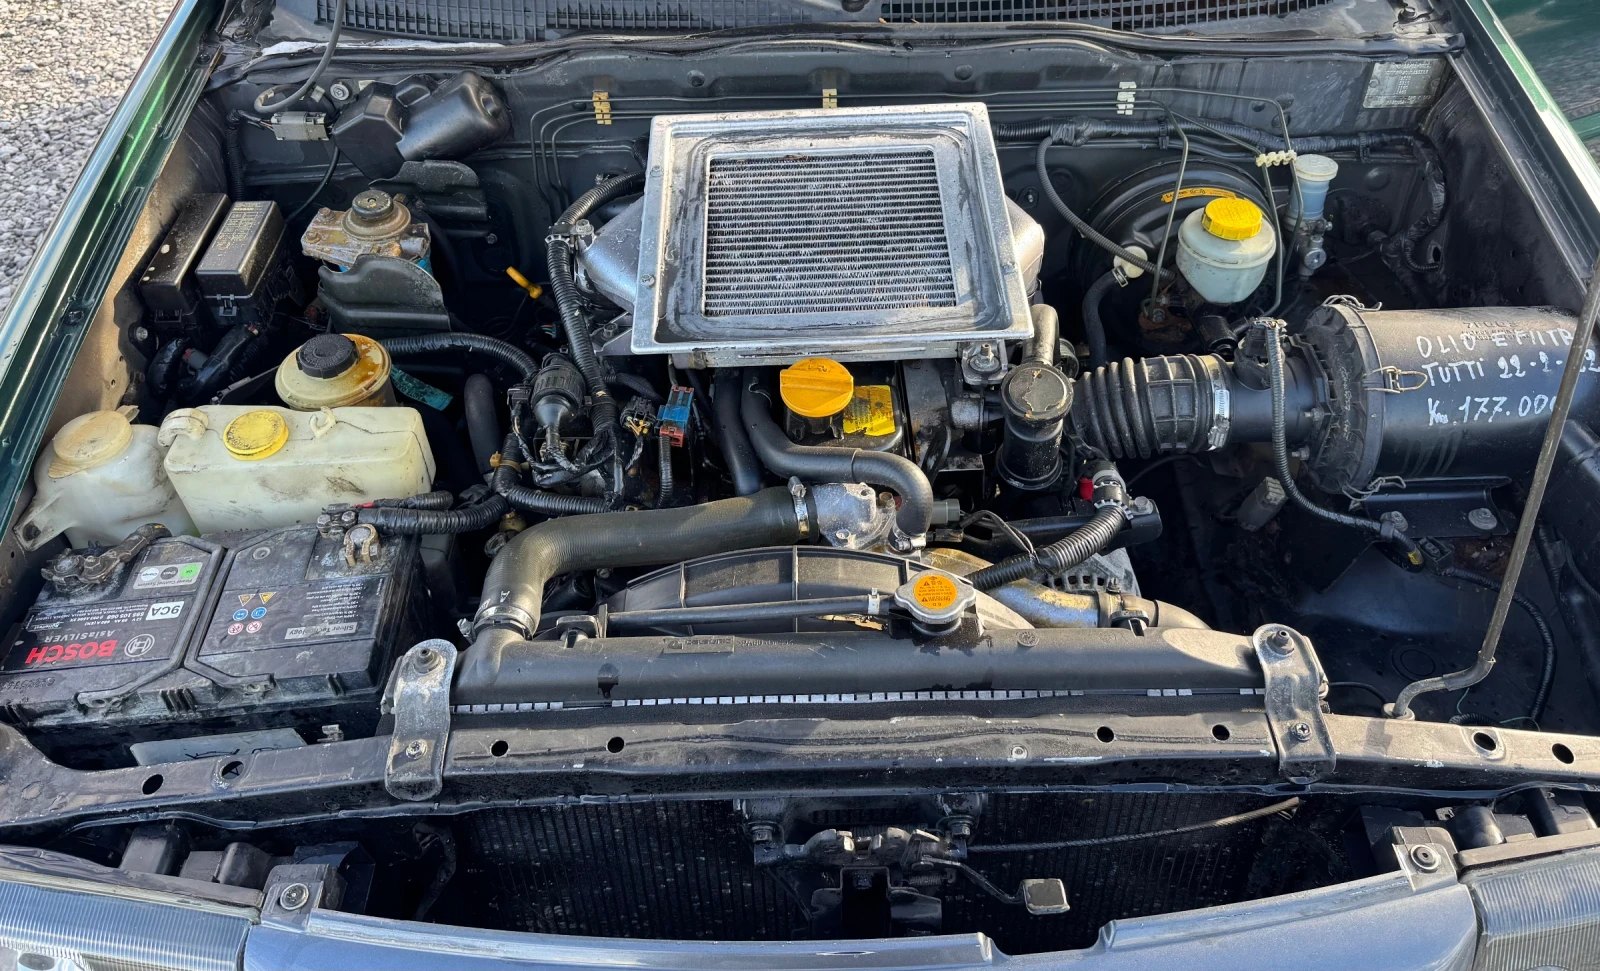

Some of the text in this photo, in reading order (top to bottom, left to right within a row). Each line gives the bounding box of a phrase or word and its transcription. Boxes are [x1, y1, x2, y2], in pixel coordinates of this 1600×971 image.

[1416, 335, 1476, 358] OLIO
[151, 604, 181, 617] 9CA
[44, 629, 115, 643] AsiaSILVER
[25, 640, 118, 664] BOSCH
